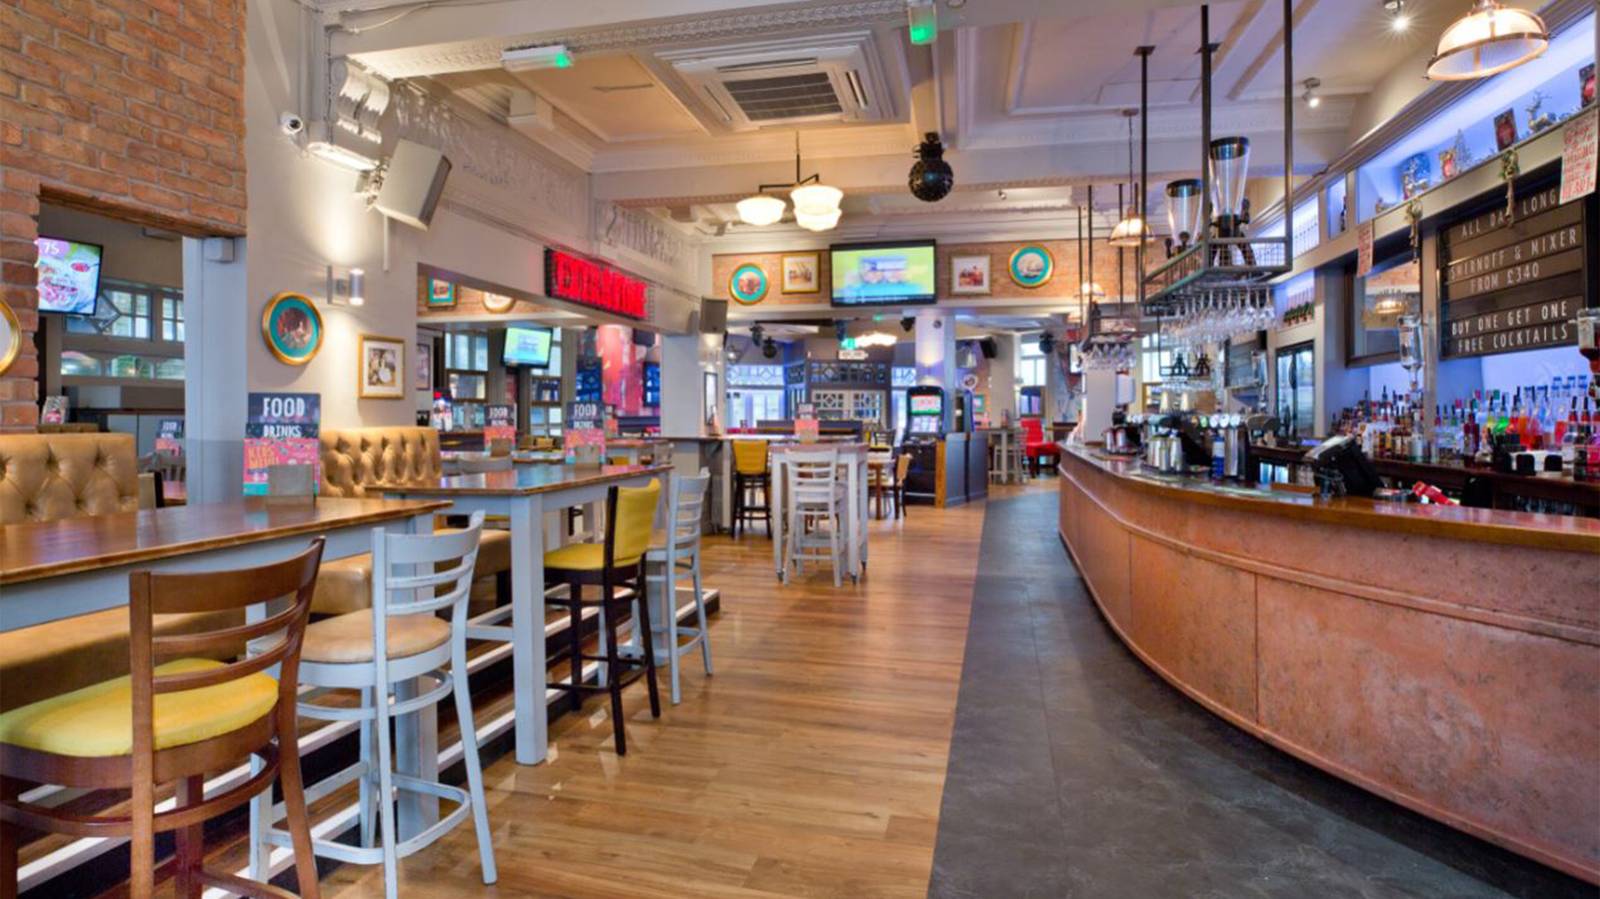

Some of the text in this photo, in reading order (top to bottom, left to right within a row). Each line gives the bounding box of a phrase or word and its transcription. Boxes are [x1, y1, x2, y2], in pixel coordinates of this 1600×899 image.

[1462, 218, 1481, 238] ALL
[1523, 190, 1556, 214] LONG
[1514, 245, 1522, 260] &
[1531, 228, 1577, 255] MIXER
[1471, 274, 1499, 294] FROM
[1452, 301, 1568, 336] BUY ONE GET ONE
[1458, 324, 1568, 353] FREE COCKTAILS
[263, 397, 306, 417] FOOD
[574, 403, 597, 417] FOOD
[263, 424, 302, 438] DRINKS
